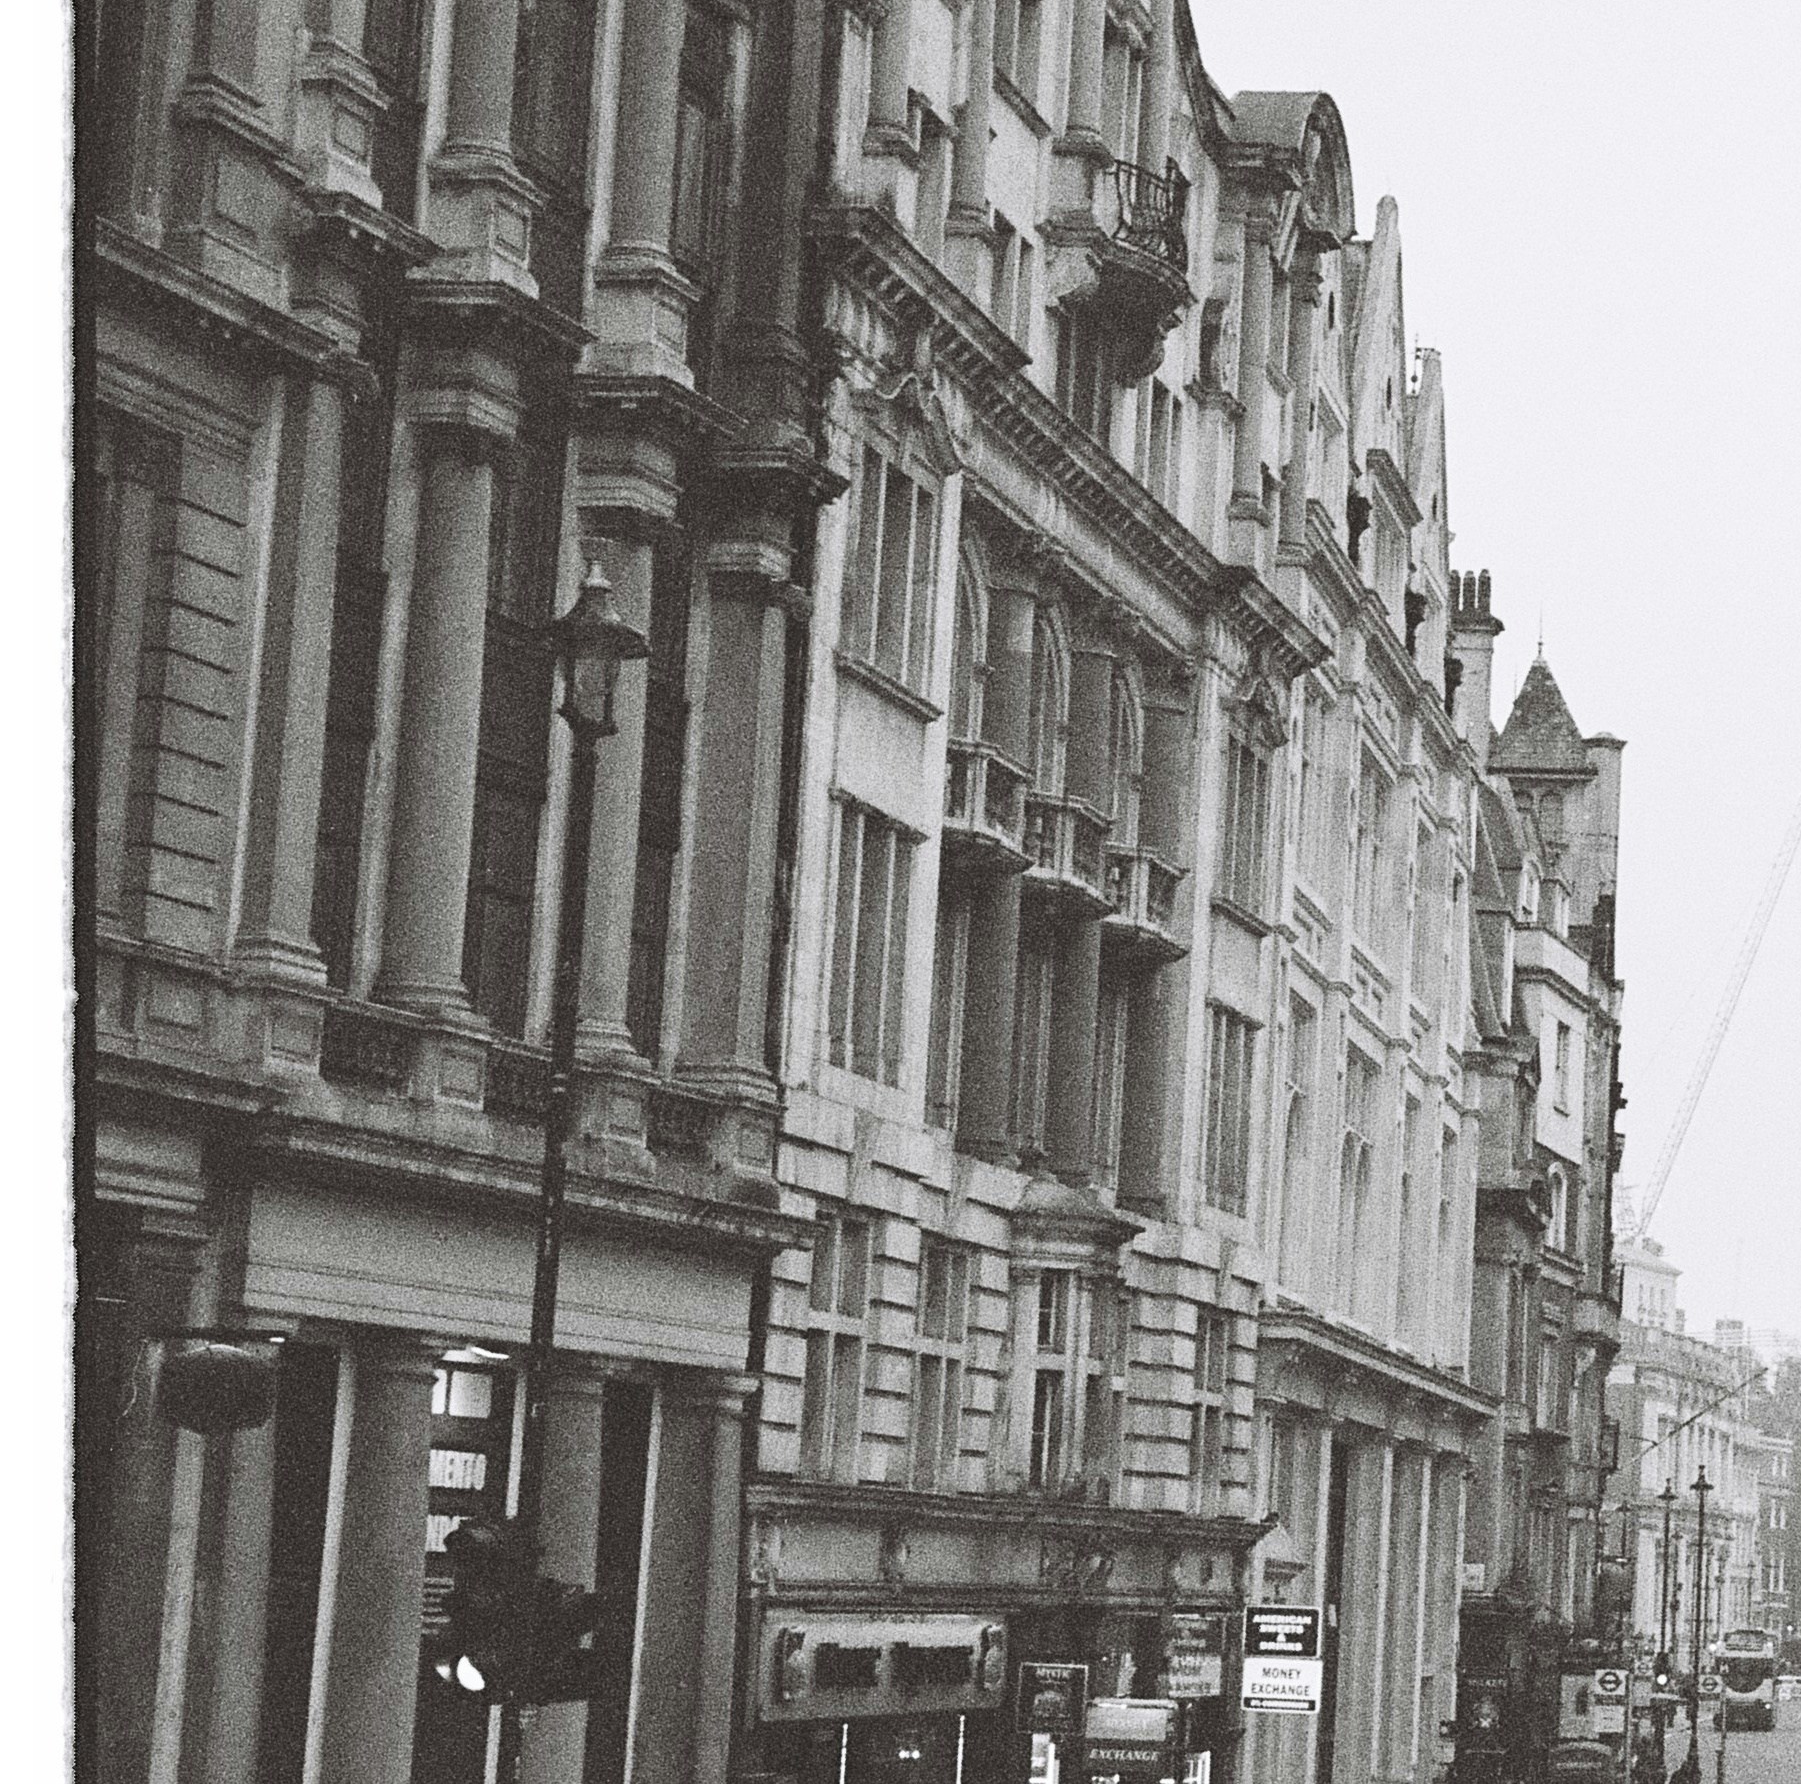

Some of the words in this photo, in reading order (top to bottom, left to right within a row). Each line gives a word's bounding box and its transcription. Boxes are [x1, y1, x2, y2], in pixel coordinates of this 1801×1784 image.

[1253, 1614, 1312, 1625] AMERICAN
[1261, 1667, 1302, 1679] MONEY
[1250, 1682, 1310, 1696] EXCHANGE
[1089, 1748, 1161, 1762] EXCHANGE
